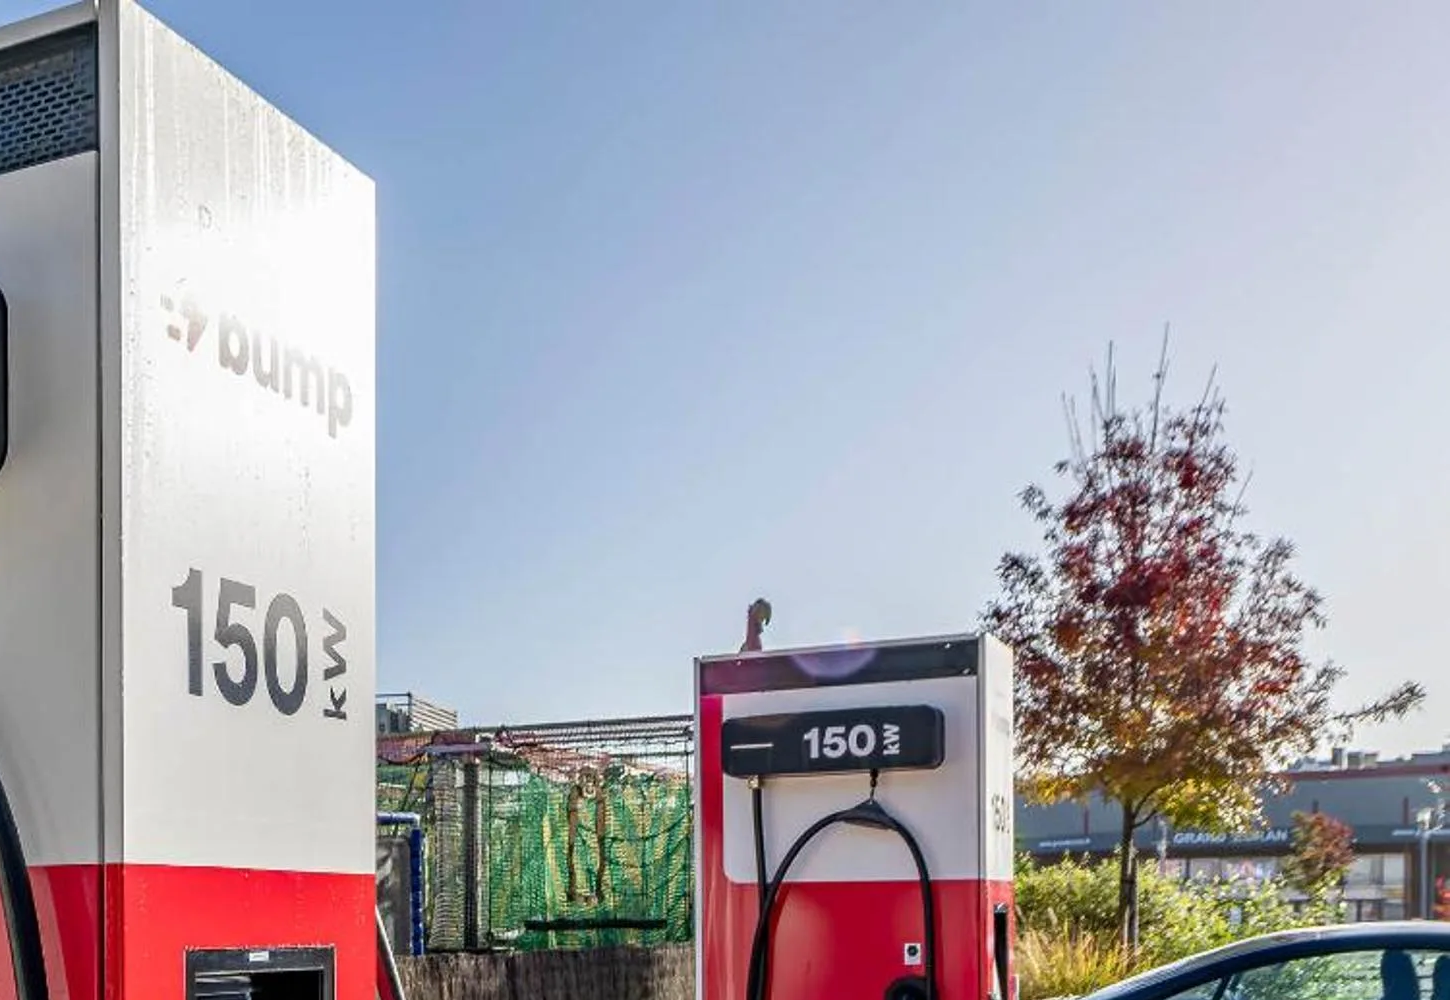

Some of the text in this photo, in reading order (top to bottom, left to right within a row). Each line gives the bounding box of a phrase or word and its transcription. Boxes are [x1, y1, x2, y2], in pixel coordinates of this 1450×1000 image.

[218, 311, 353, 438] bump
[171, 567, 347, 720] 150 kW
[803, 723, 900, 758] 150 kW
